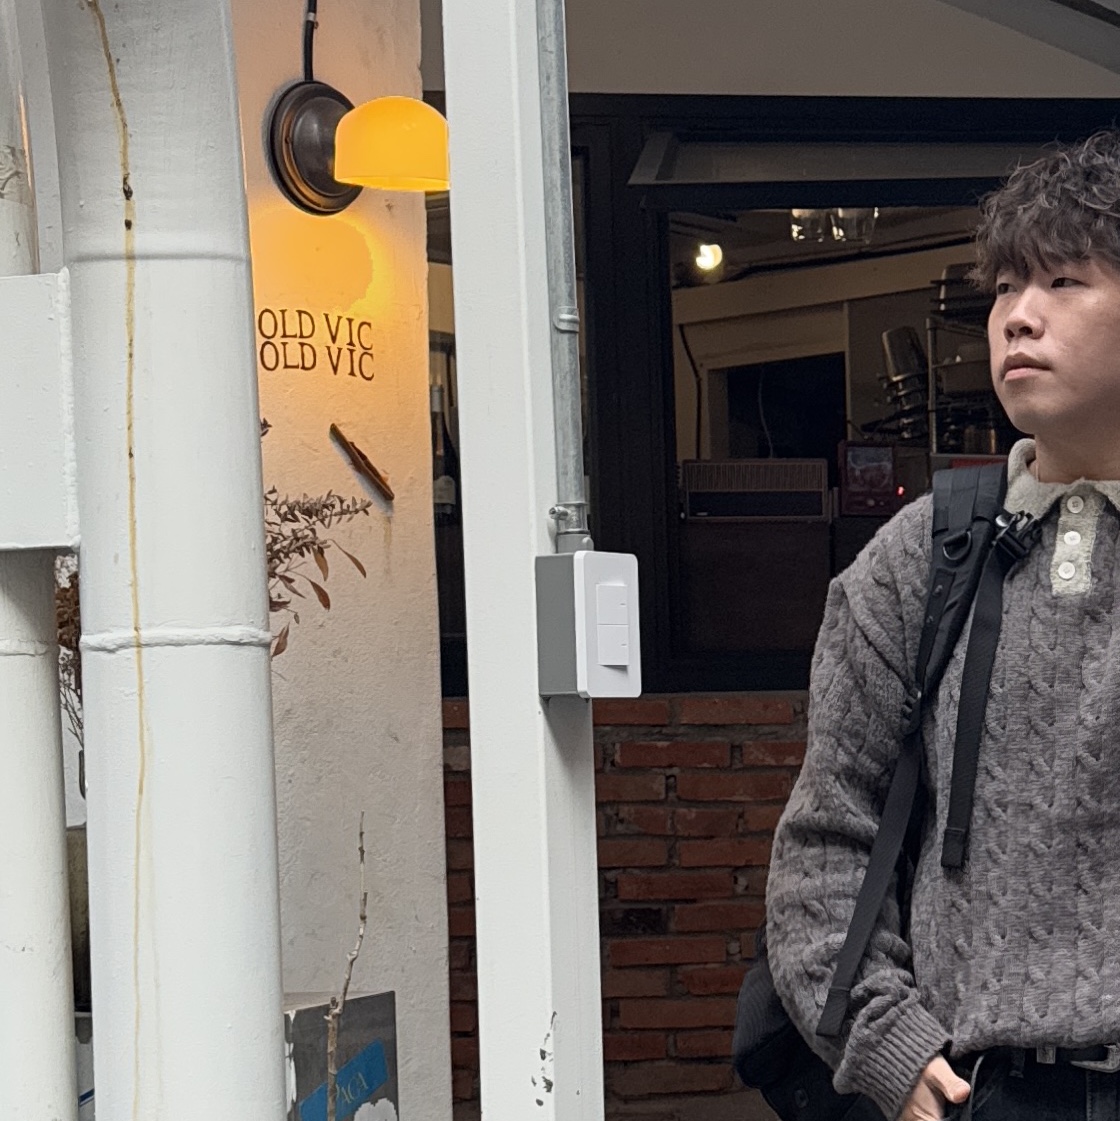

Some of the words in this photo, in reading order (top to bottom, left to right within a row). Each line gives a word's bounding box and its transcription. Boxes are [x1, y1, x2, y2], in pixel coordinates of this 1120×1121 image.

[258, 308, 316, 339] OLD
[323, 312, 374, 351] VIC
[260, 340, 317, 372] OLD
[325, 345, 375, 381] VIC
